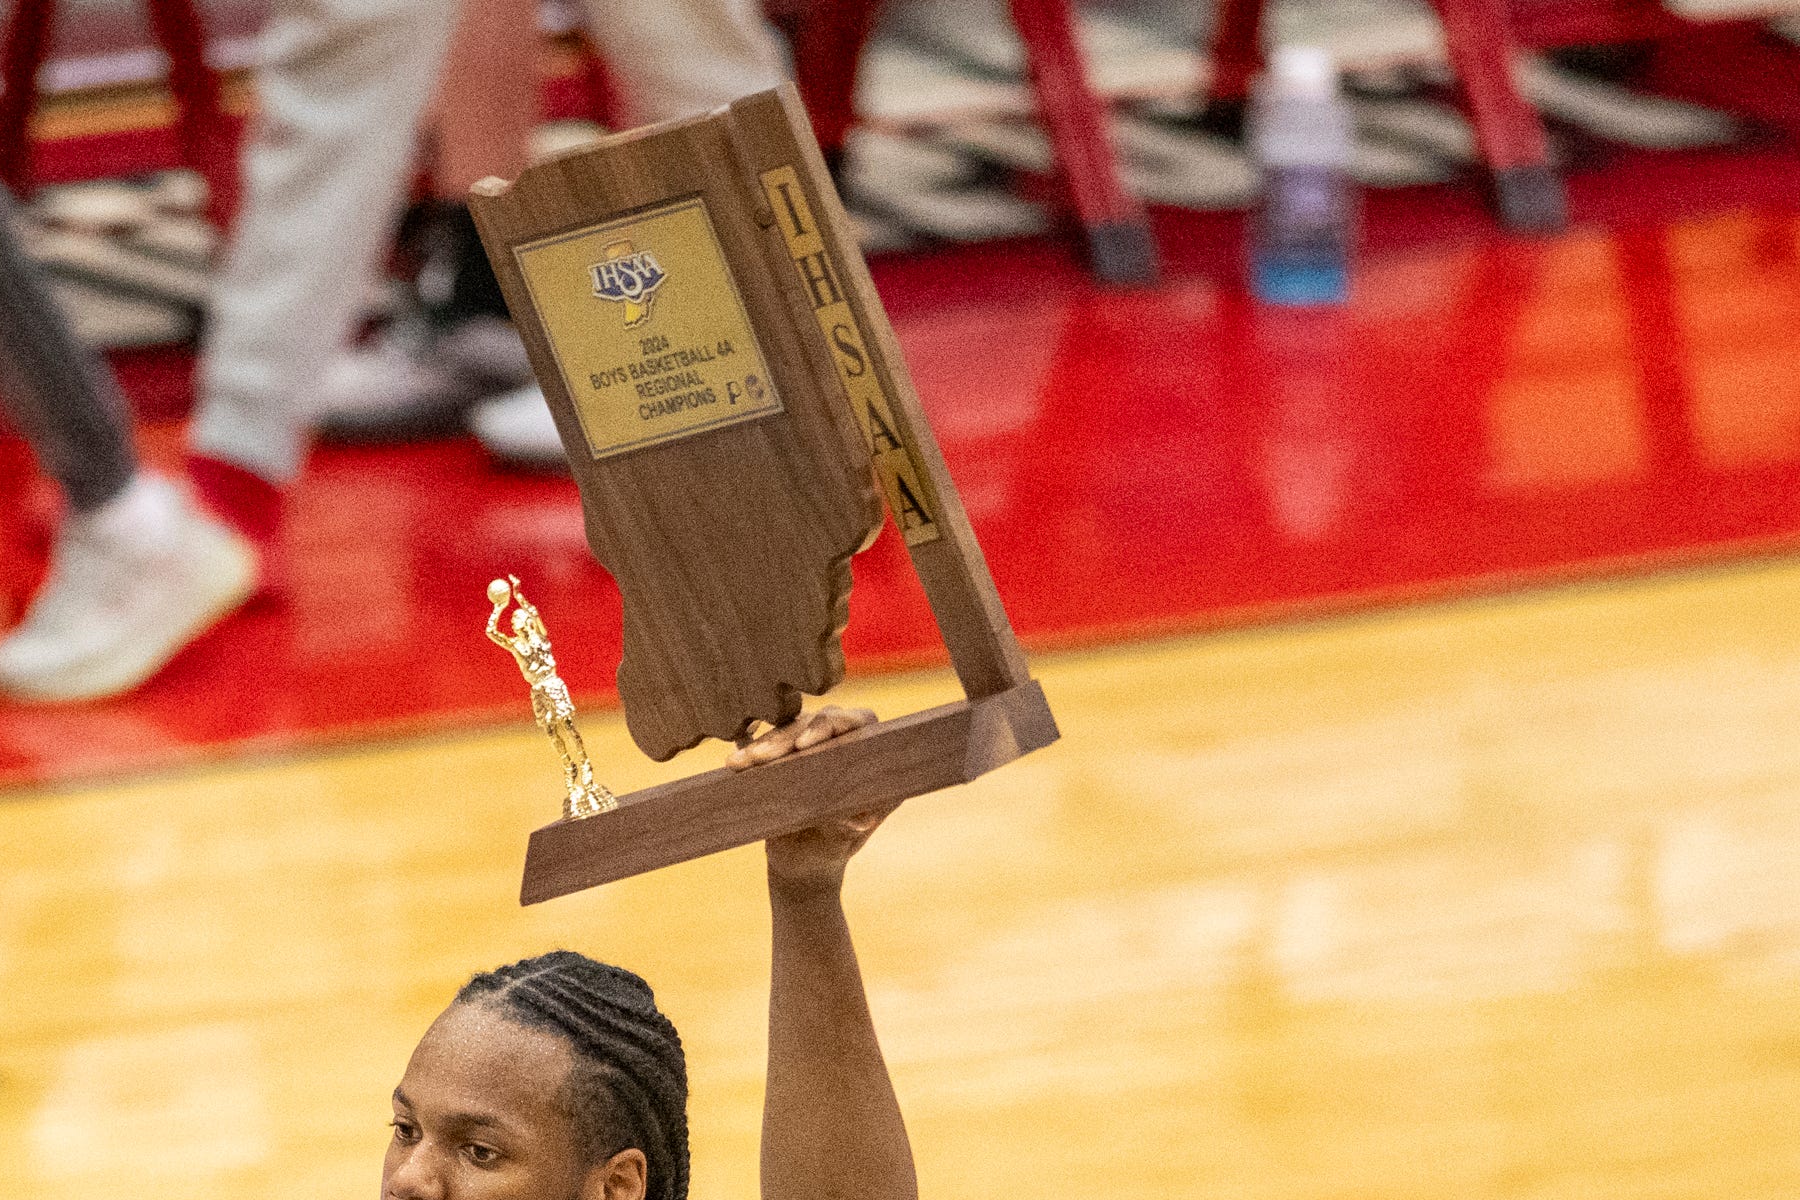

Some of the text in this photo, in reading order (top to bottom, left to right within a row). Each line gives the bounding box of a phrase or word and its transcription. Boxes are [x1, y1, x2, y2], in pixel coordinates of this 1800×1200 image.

[591, 251, 664, 297] IHSAA
[590, 339, 735, 390] BOYS BASKETBALL 4A
[639, 334, 670, 356] 2024
[777, 182, 934, 532] IHSAA
[635, 368, 704, 399] REGIONAL
[638, 387, 717, 421] CHAMPIONS
